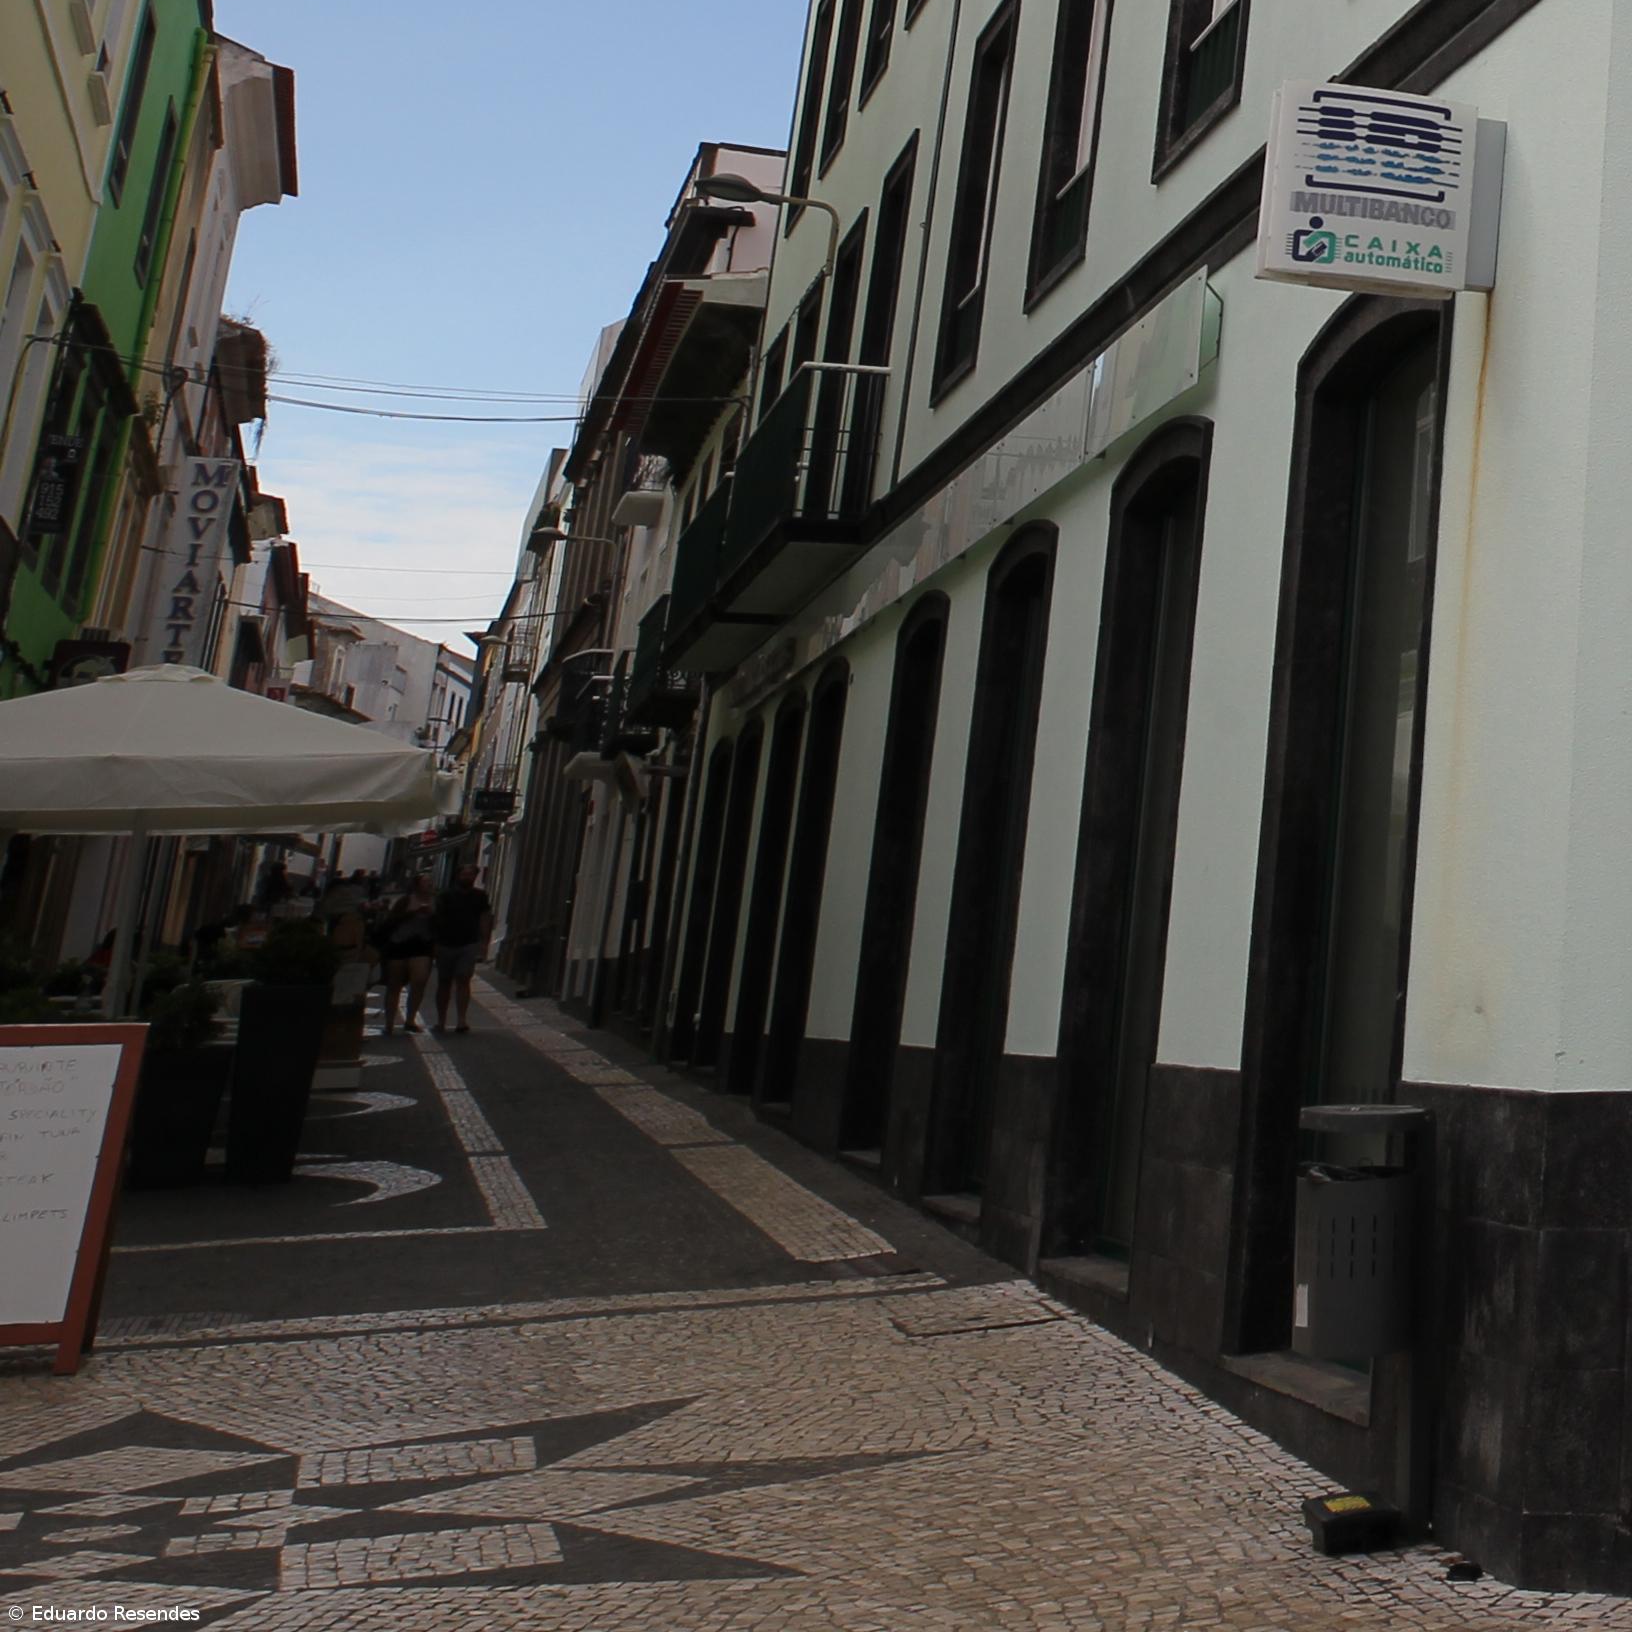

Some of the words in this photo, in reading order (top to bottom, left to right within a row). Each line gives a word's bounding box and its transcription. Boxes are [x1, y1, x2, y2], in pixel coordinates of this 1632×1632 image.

[1291, 191, 1455, 230] MULTIBANCO
[1344, 234, 1443, 258] CAIXA
[1343, 250, 1443, 274] automático
